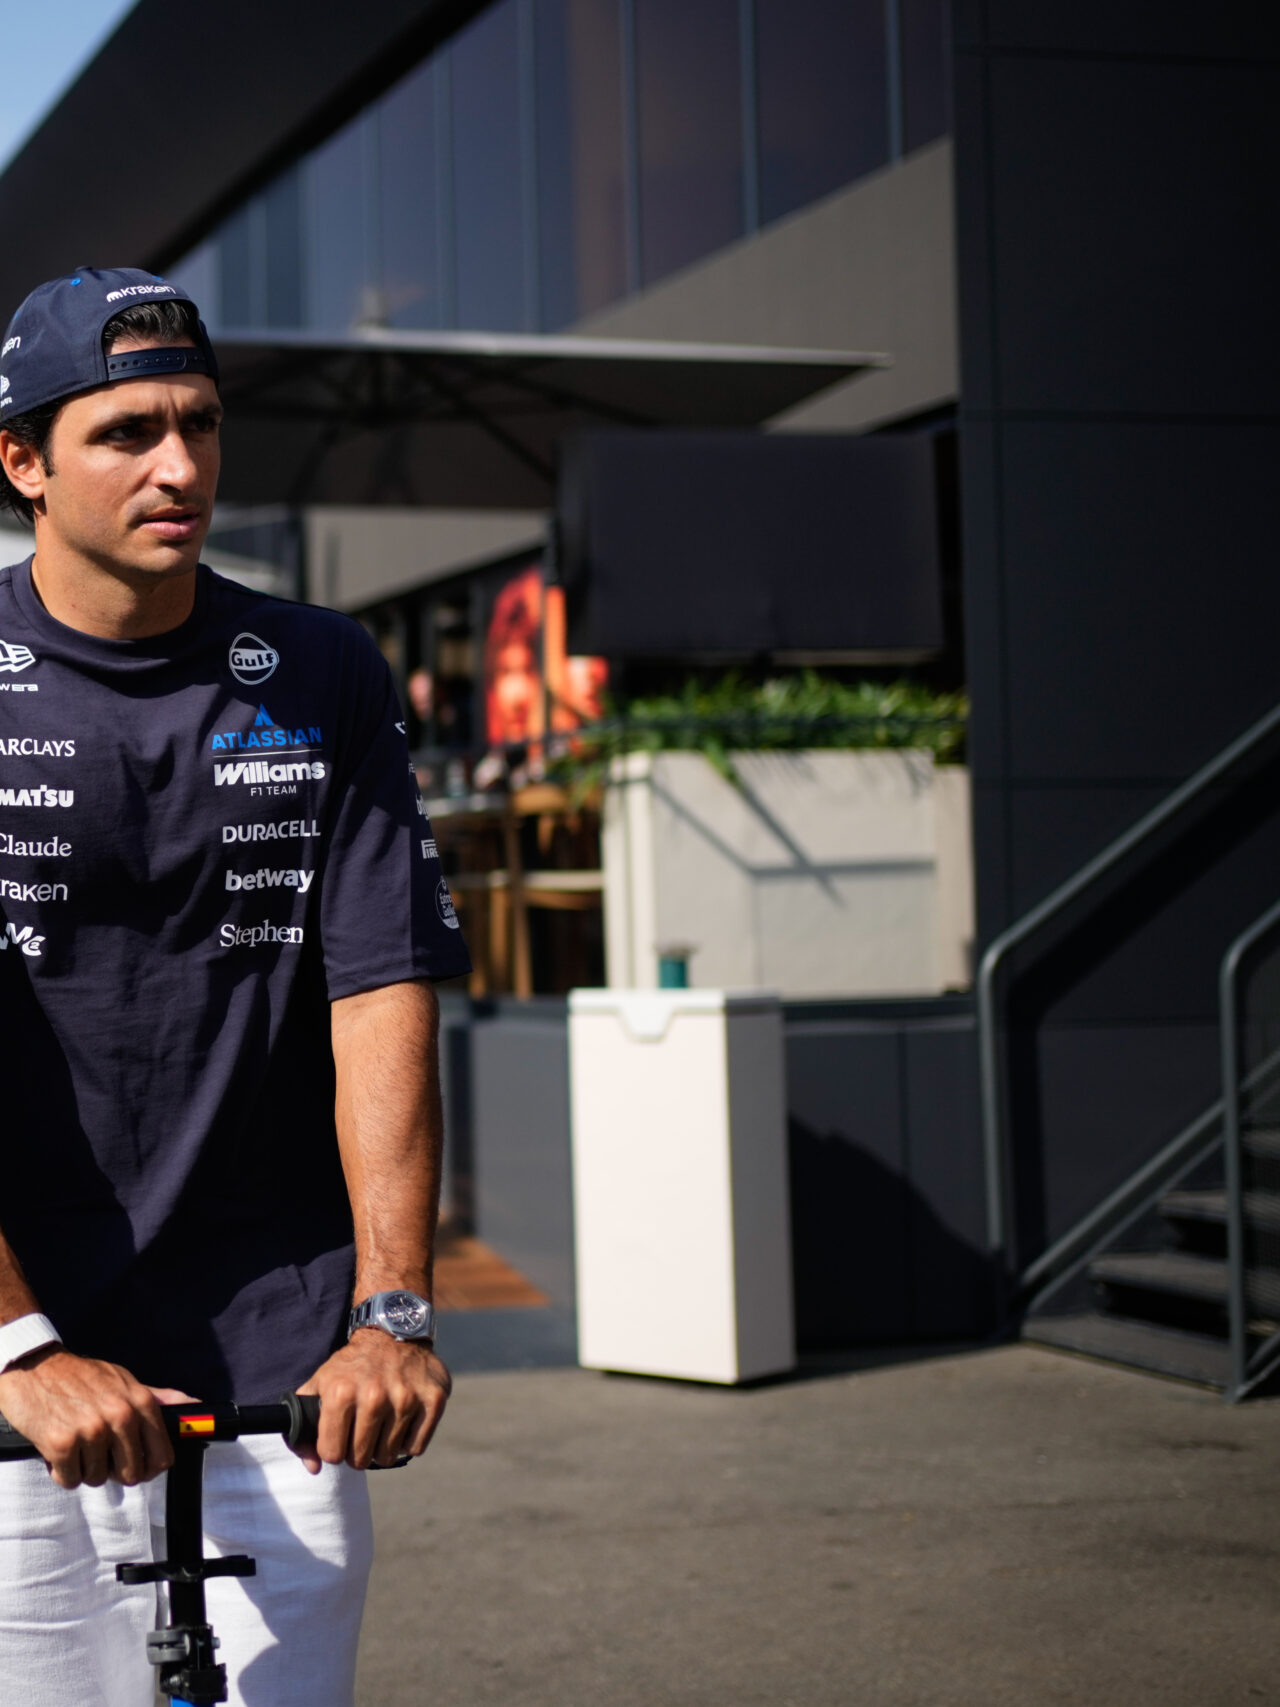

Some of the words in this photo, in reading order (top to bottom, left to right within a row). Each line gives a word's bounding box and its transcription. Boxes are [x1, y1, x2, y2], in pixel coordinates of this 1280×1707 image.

[120, 285, 177, 297] kraken
[231, 651, 274, 667] Gulf
[212, 727, 322, 750] ATLASSIAN
[213, 761, 326, 786] Williams
[250, 787, 262, 797] F1
[267, 785, 297, 795] TEAM
[222, 819, 321, 843] DURACELL
[224, 868, 315, 893] betway
[219, 919, 304, 947] Stephen
